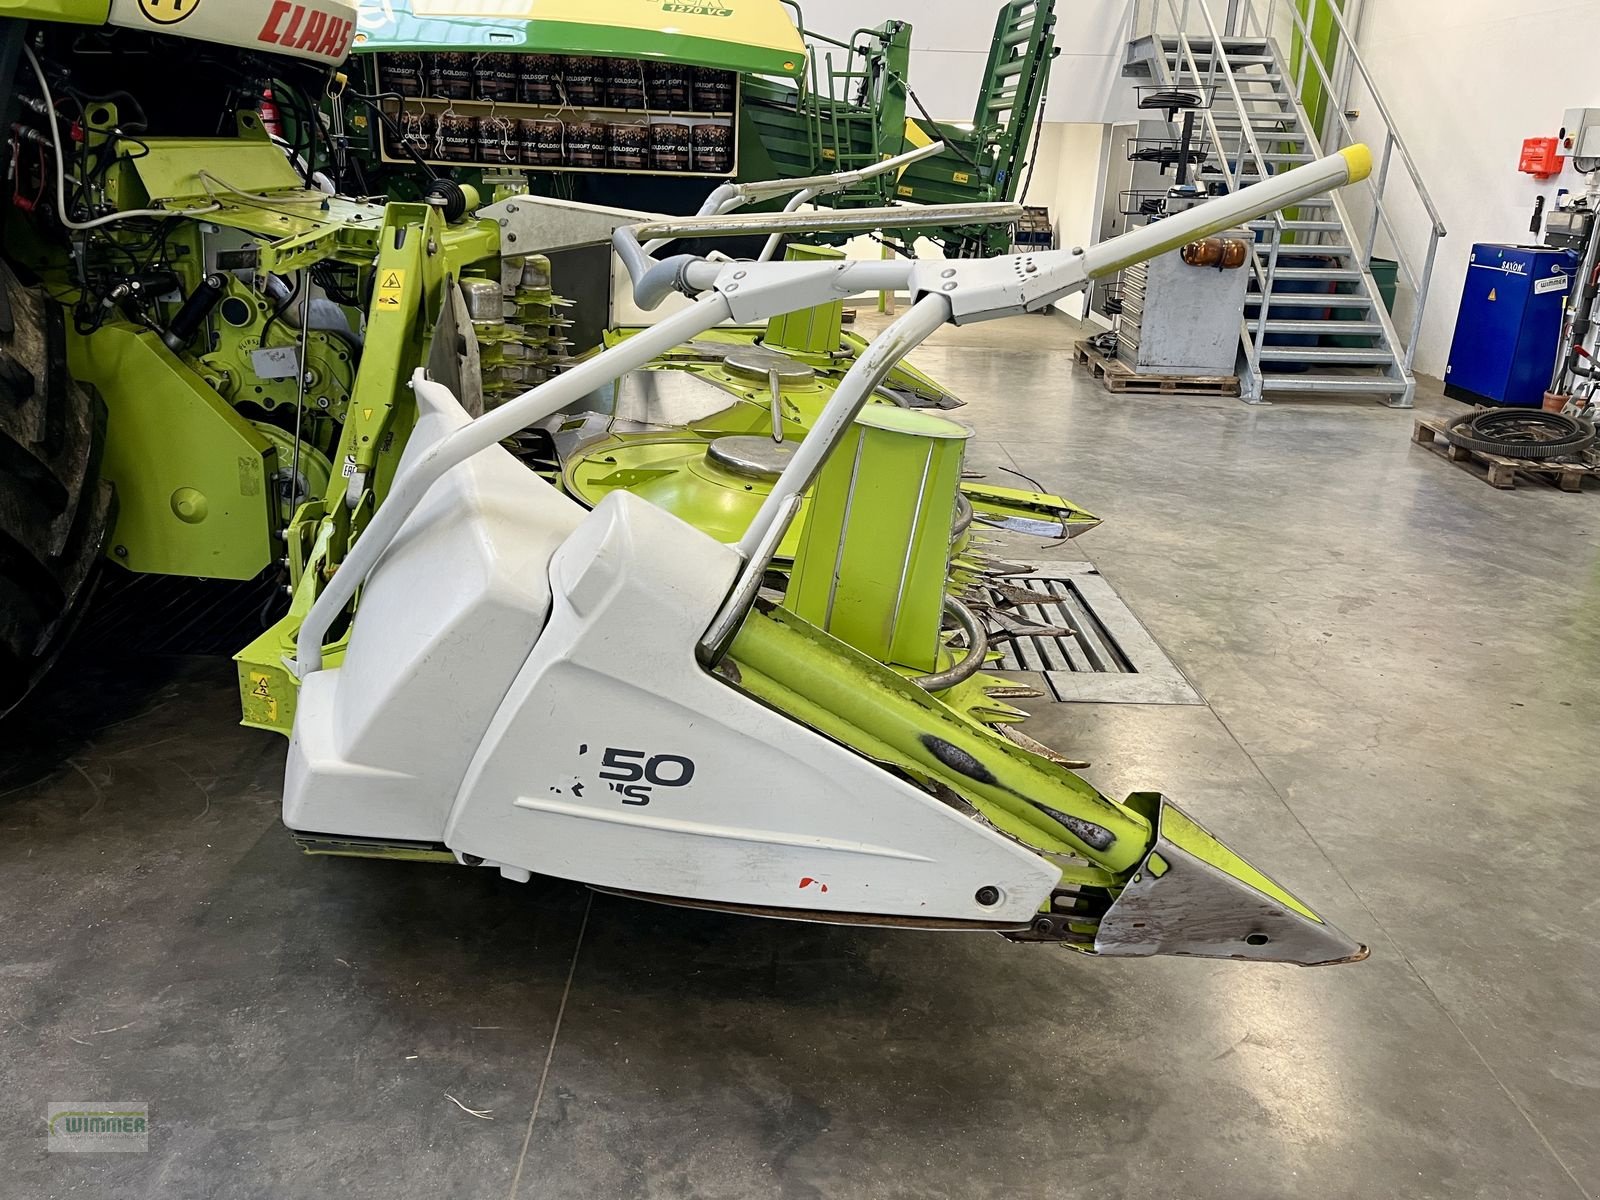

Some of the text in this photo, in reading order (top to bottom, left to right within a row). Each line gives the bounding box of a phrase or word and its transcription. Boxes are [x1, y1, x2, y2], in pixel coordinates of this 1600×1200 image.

[669, 4, 727, 16] 1270 VC
[258, 0, 353, 58] CLAAS
[1501, 260, 1523, 273] SAXON
[1540, 278, 1567, 288] WIMMER
